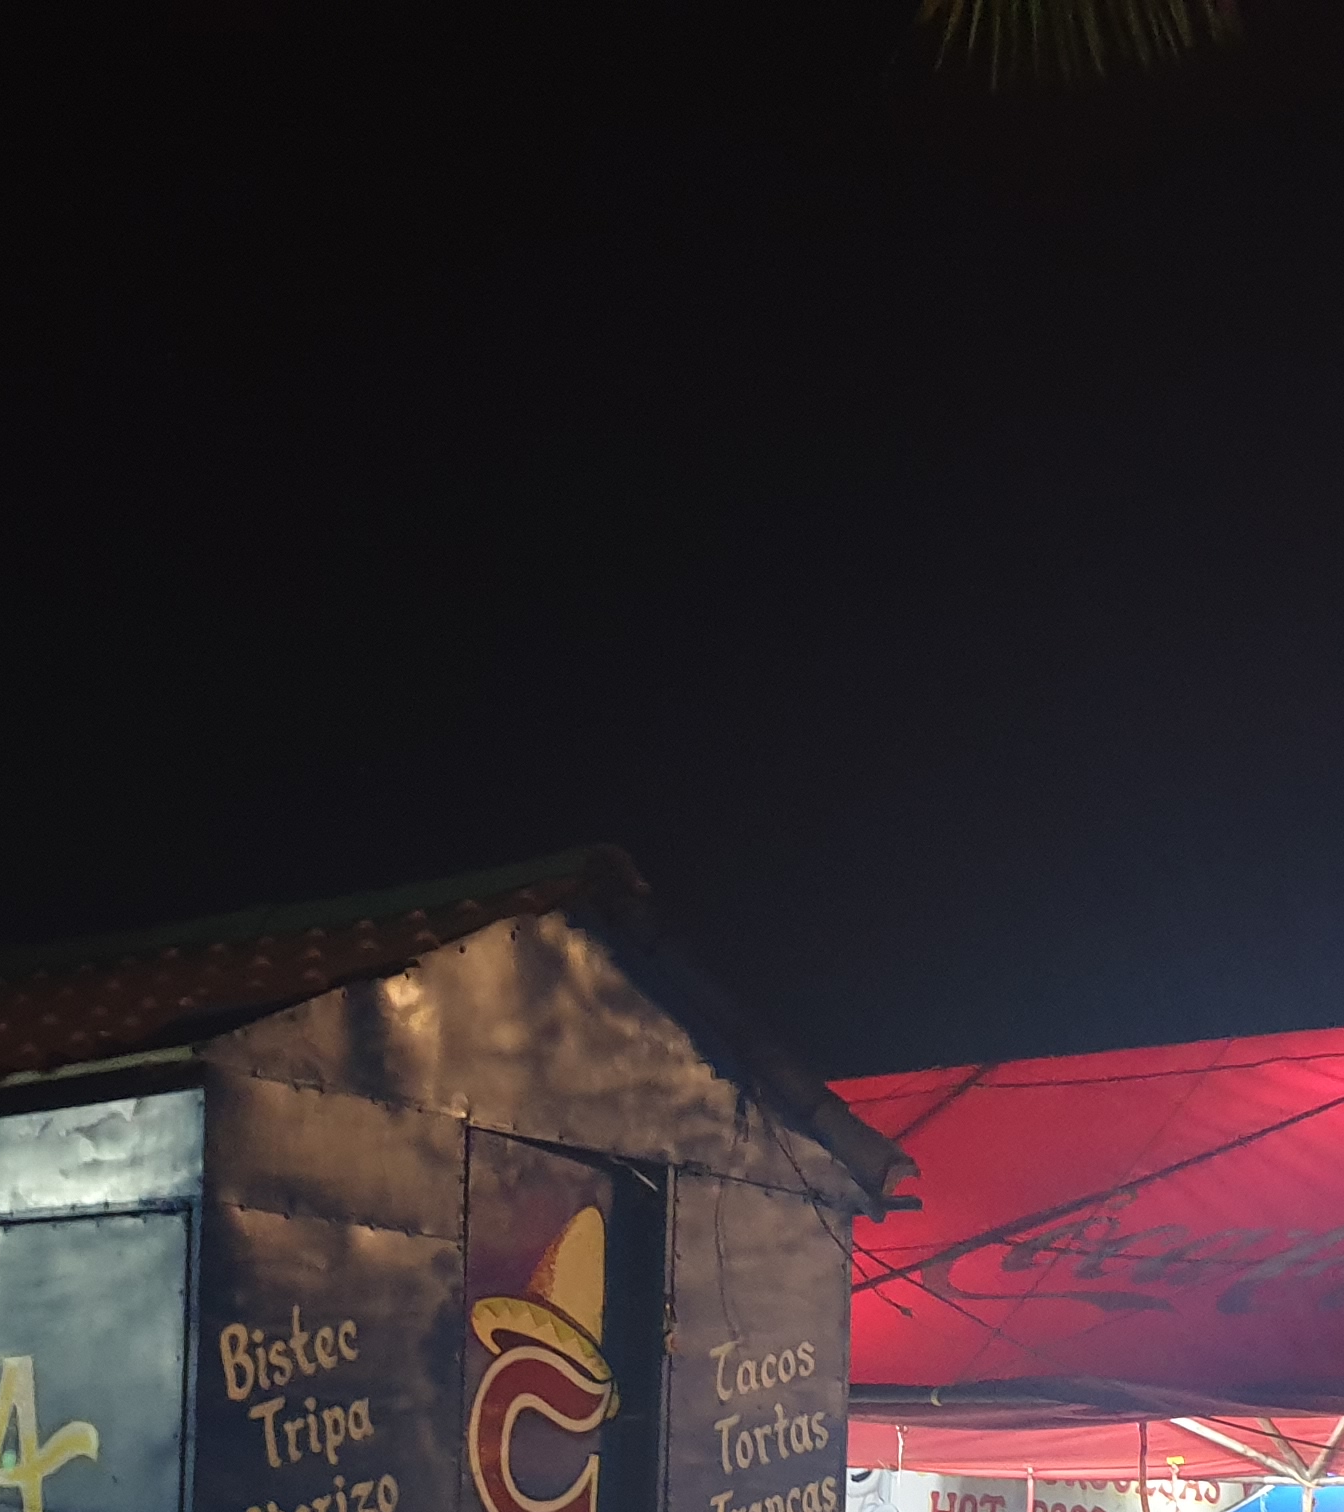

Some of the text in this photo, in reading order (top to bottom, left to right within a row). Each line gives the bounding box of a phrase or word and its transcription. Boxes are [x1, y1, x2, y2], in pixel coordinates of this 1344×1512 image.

[220, 1304, 359, 1400] Bistec
[709, 1337, 816, 1402] Tacos
[249, 1396, 375, 1468] Tripa
[713, 1402, 830, 1475] Tortas
